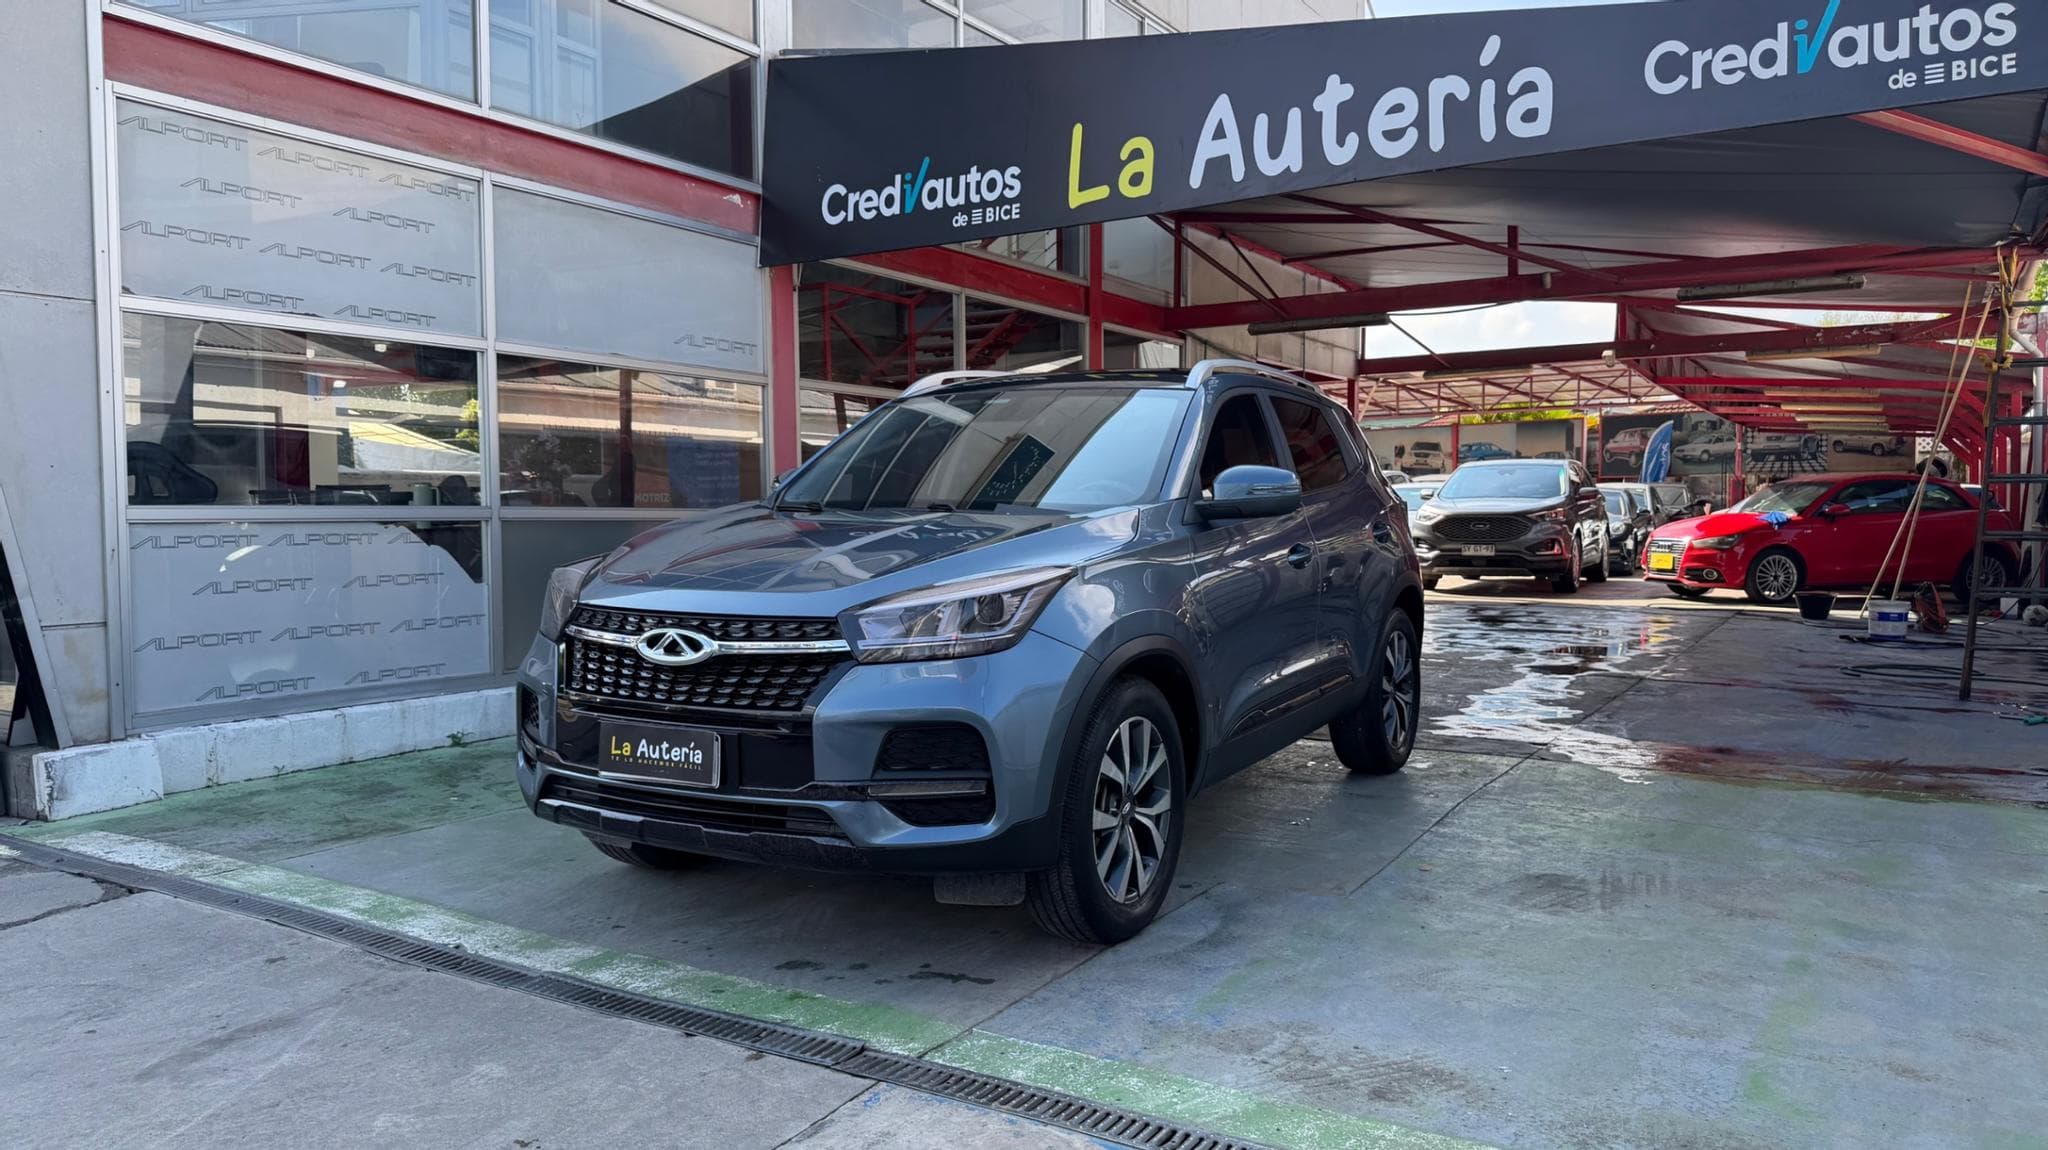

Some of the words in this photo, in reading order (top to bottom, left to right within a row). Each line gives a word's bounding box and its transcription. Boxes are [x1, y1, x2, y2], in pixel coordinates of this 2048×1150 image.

[1888, 69, 1917, 90] de
[1952, 52, 2017, 82] BICE
[1068, 122, 1155, 209] La
[1188, 34, 1554, 189] Autería
[117, 115, 248, 151] ALPORT
[257, 146, 369, 178] ALPORT
[379, 173, 475, 202] ALPORT
[180, 177, 303, 208] ALPORT
[333, 206, 436, 234] ALPORT
[952, 211, 968, 228] de
[985, 203, 1021, 223] BICE
[120, 220, 251, 249] ALPORT
[259, 242, 371, 269] ALPORT
[380, 263, 477, 287] ALPORT
[182, 284, 304, 310] ALPORT
[334, 304, 437, 327] ALPORT
[672, 334, 758, 356] ALPORT
[130, 534, 259, 550] ALPORT
[267, 532, 379, 546] ALPORT
[192, 577, 313, 596] ALPORT
[342, 572, 445, 589] ALPORT
[133, 630, 262, 653] ALPORT
[270, 622, 381, 642] ALPORT
[390, 614, 486, 633] ALPORT
[196, 676, 316, 702] ALPORT
[344, 663, 447, 685] ALPORT
[611, 735, 631, 756] La
[636, 738, 703, 764] Autería
